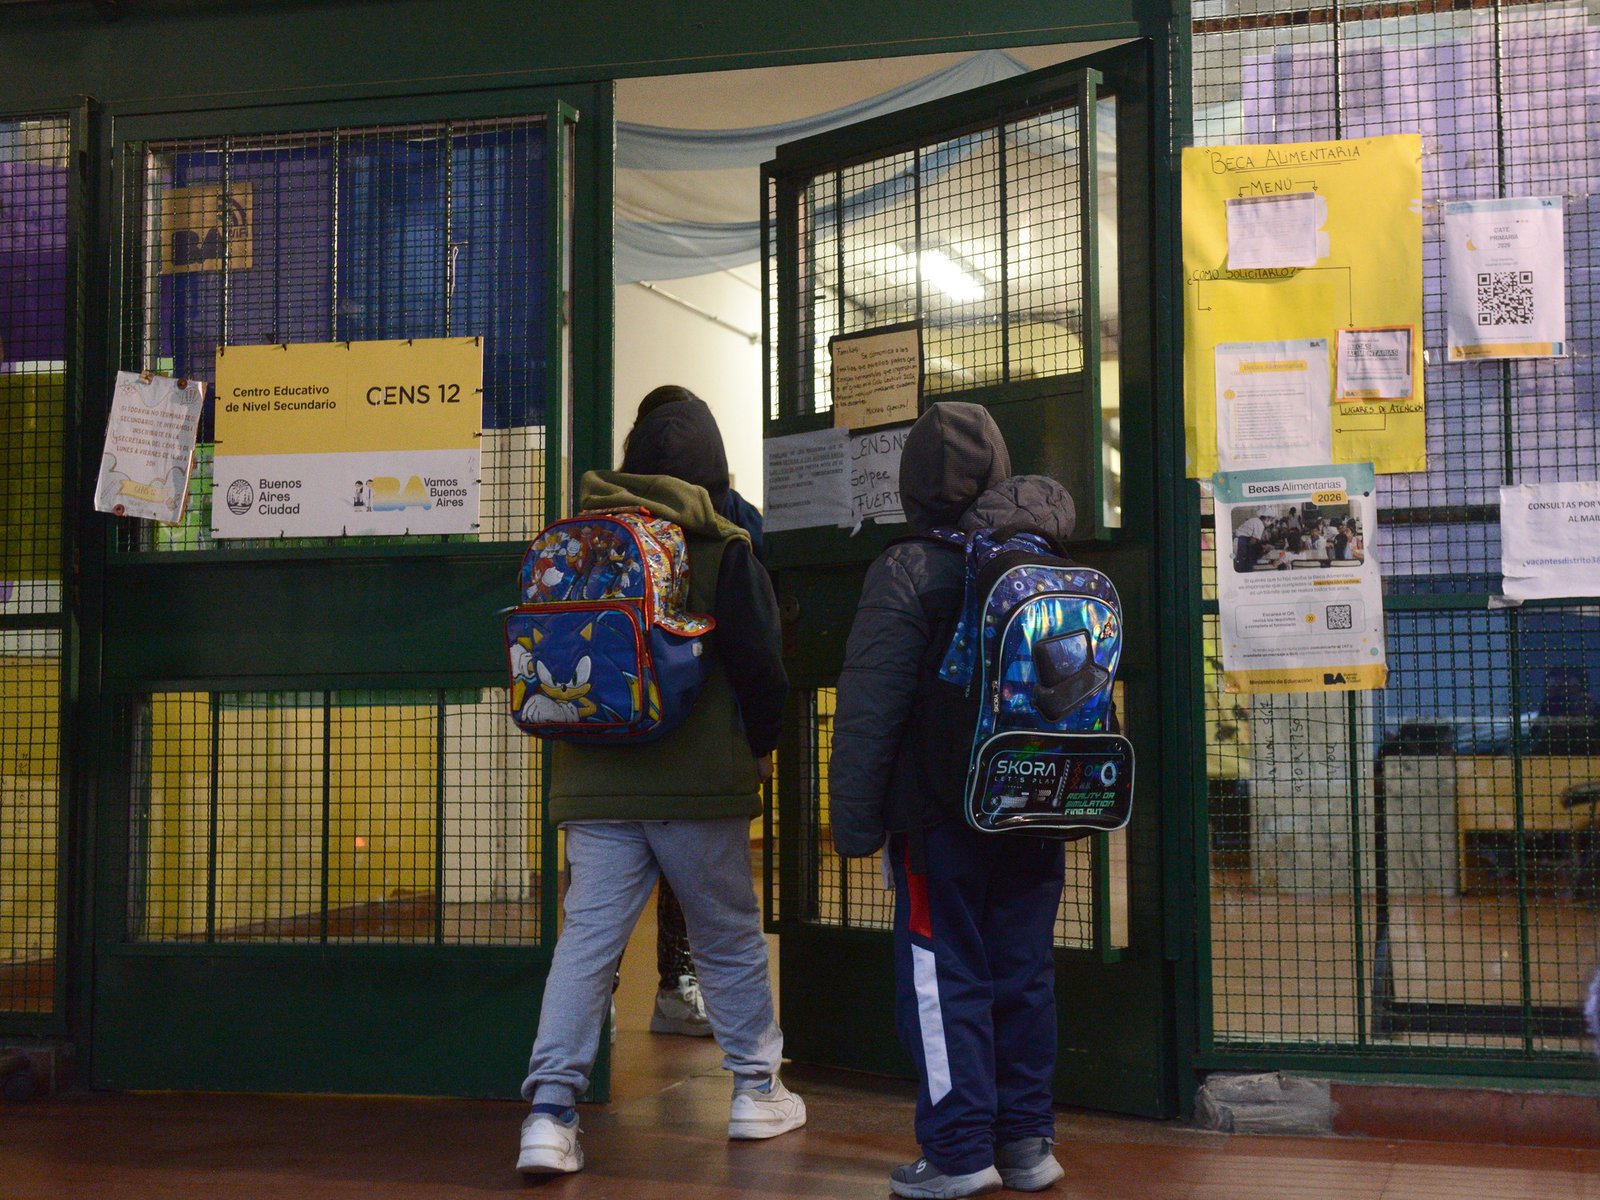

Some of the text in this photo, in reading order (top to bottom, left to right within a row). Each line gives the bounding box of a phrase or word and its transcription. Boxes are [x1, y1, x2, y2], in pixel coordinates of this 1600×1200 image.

[1251, 179, 1292, 195] MENÚ
[233, 385, 330, 397] Centro Educativo
[366, 383, 461, 406] CENS 12
[225, 399, 337, 412] de Nivel Secundario
[259, 478, 302, 490] Buenos
[423, 477, 458, 487] Vamos
[1248, 480, 1342, 494] Becas Alimentarias
[259, 491, 291, 502] Aires
[430, 487, 468, 497] Buenos
[436, 497, 464, 507] Aires
[1318, 493, 1342, 503] 2026
[258, 503, 300, 515] Ciudad
[1528, 501, 1576, 511] CONSULTAS
[1578, 501, 1596, 509] POR
[1568, 514, 1600, 523] AL MAIL
[996, 760, 1056, 777] SKORA
[1102, 792, 1116, 800] OR
